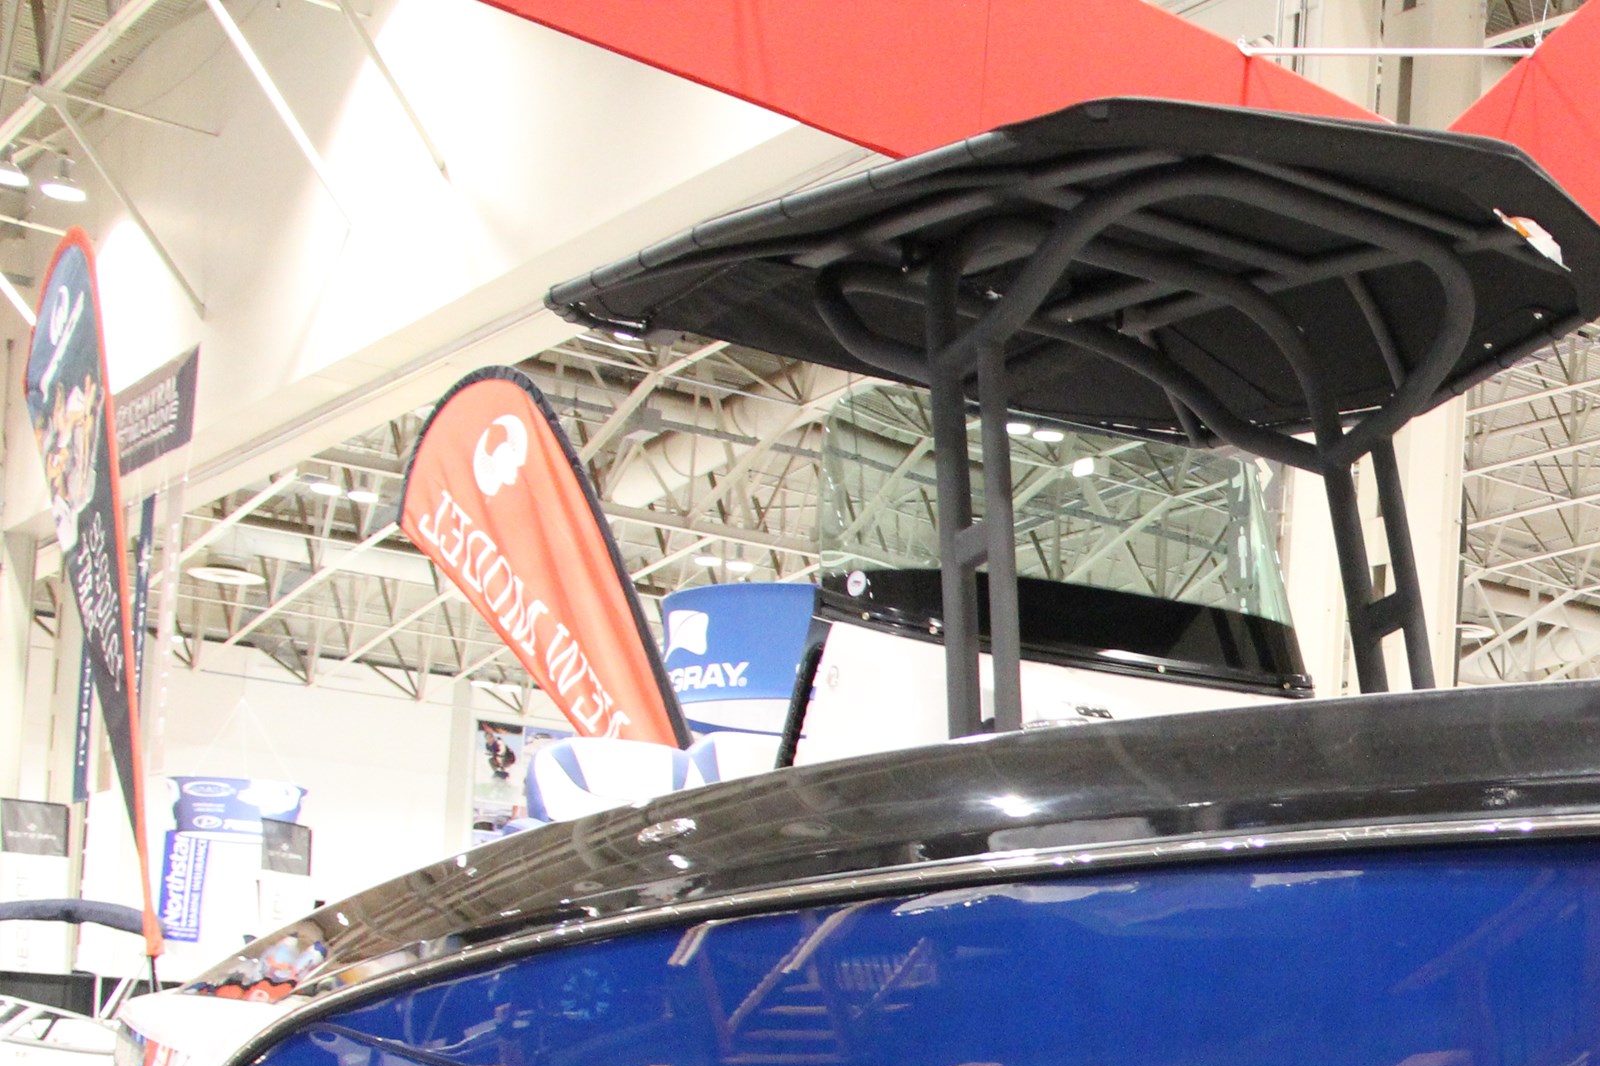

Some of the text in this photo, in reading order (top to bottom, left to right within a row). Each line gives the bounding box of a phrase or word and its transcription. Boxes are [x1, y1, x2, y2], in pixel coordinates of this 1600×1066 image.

[668, 660, 750, 693] GRAY
[163, 833, 191, 927] Northstar
[191, 839, 210, 891] INSURANC
